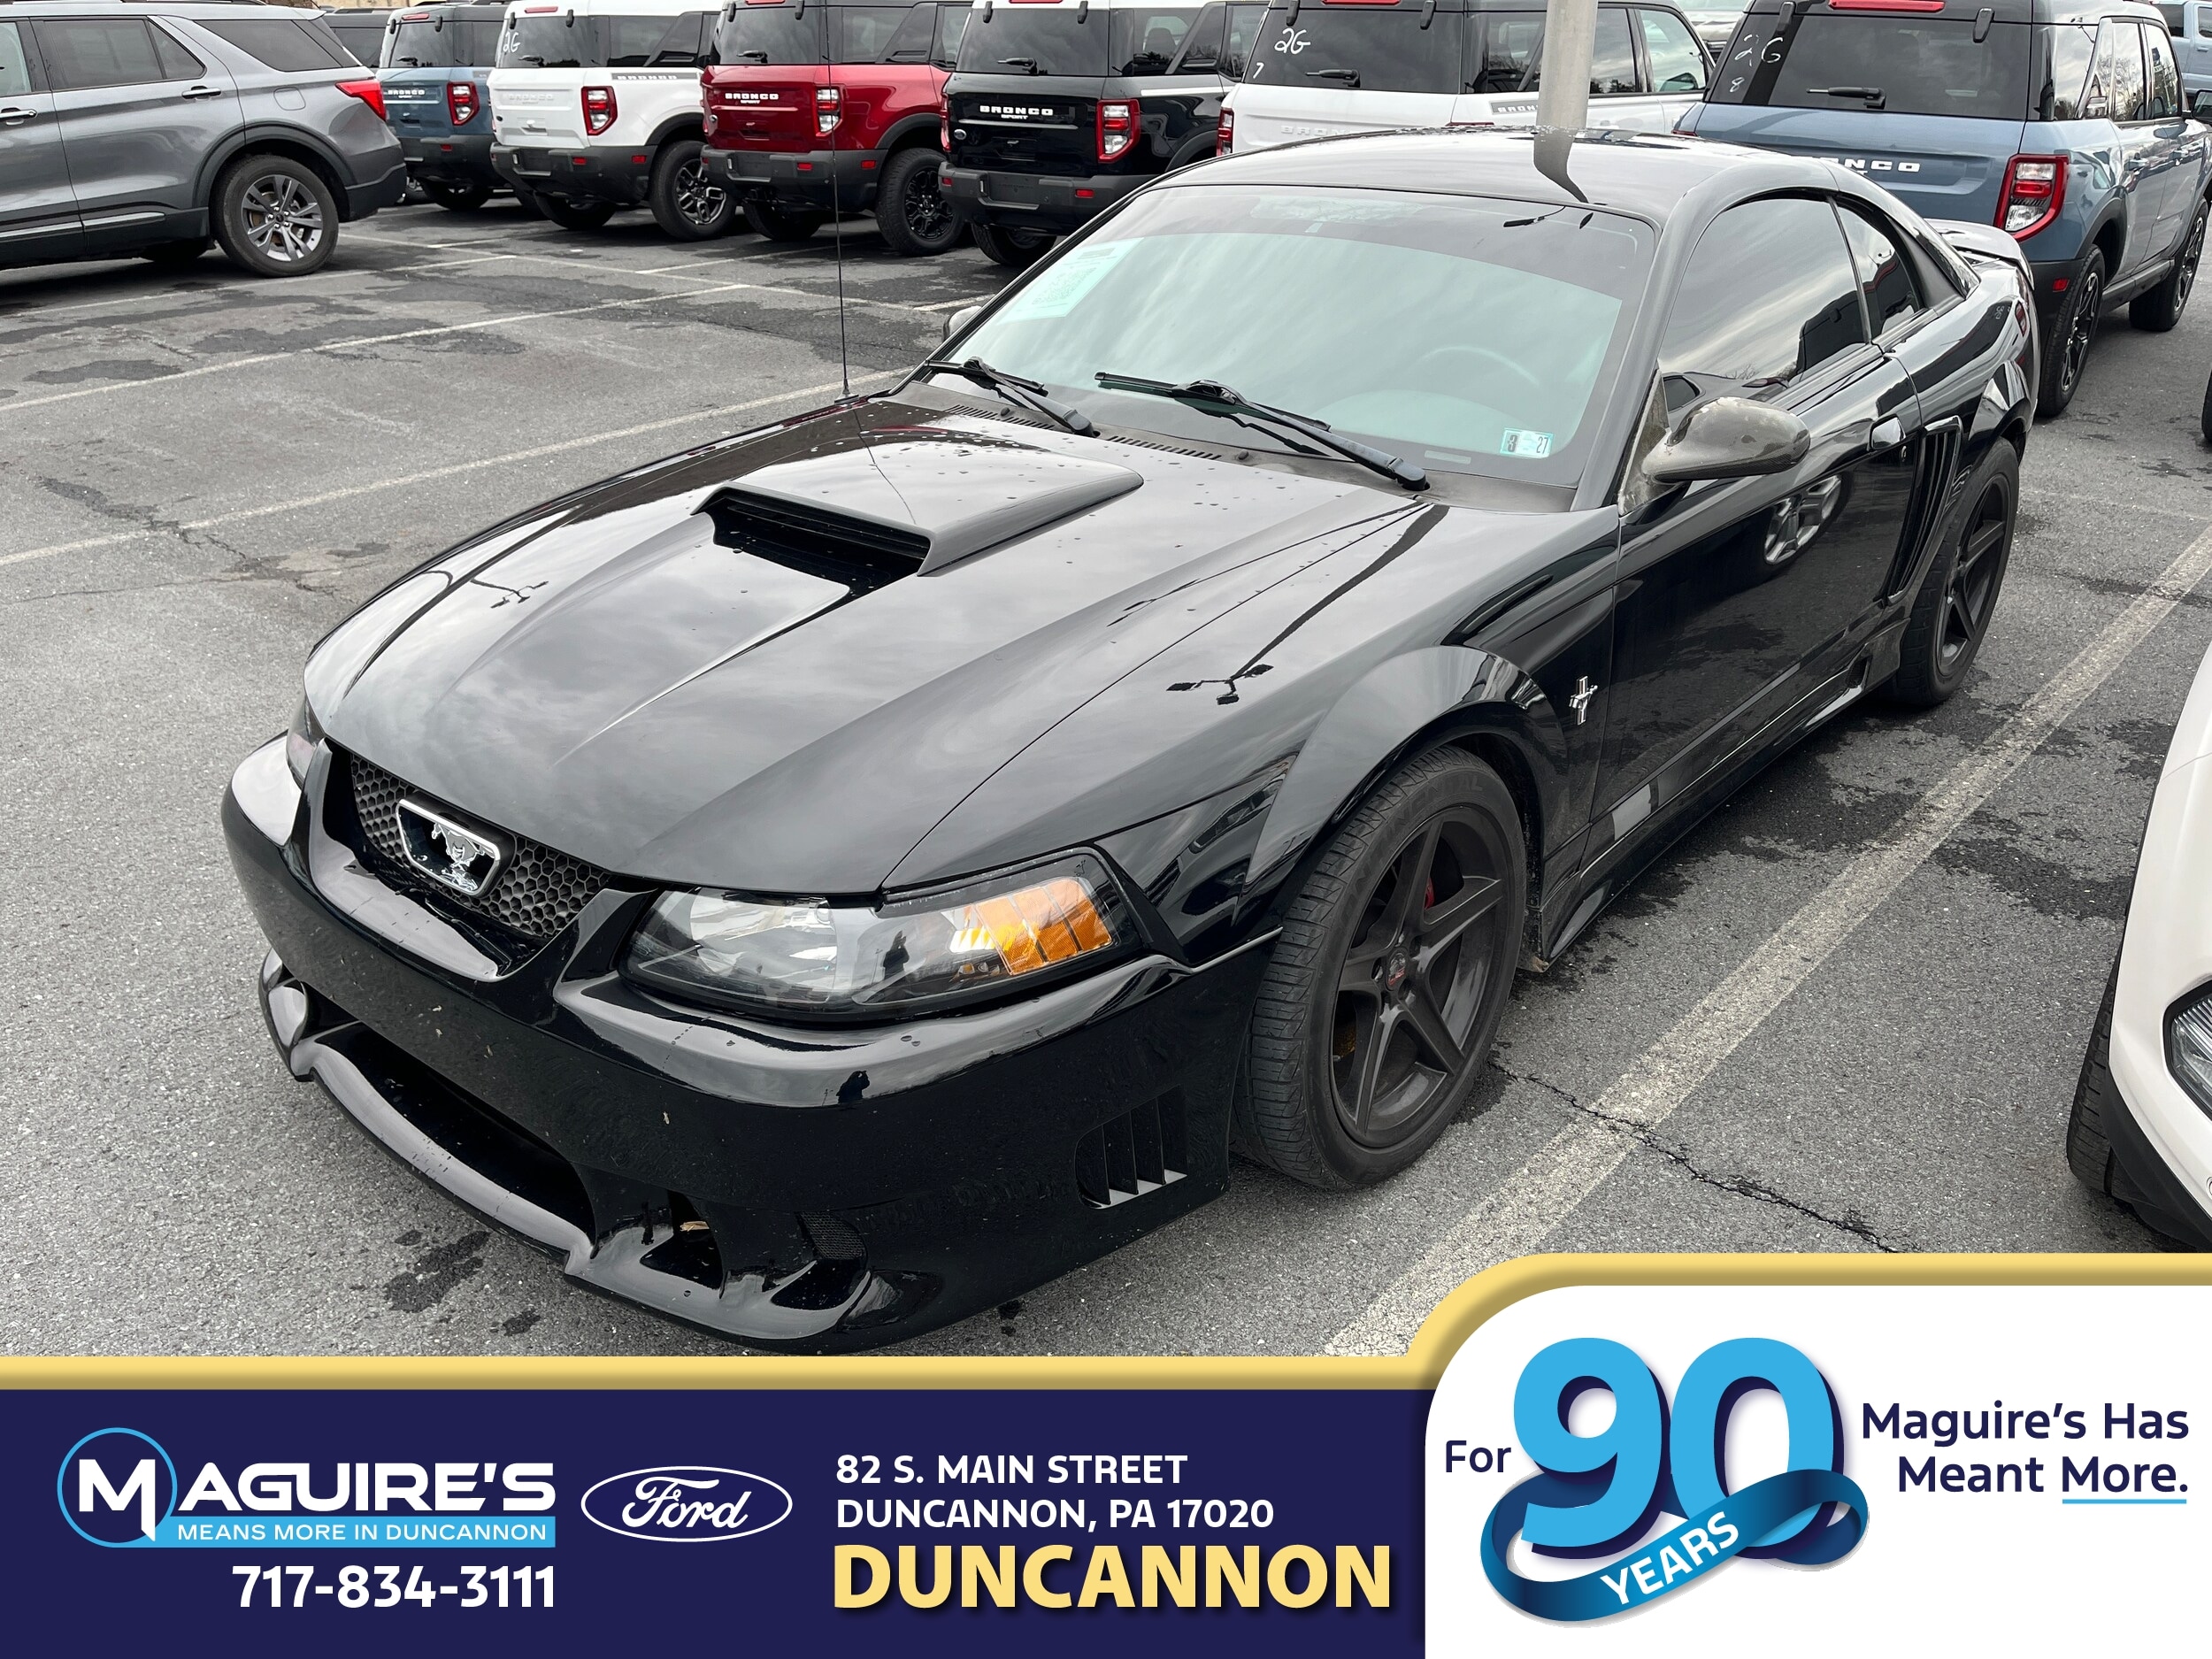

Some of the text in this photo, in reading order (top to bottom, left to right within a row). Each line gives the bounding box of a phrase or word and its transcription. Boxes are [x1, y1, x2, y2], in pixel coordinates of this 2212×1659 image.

[979, 105, 1053, 116] BRONCO
[1507, 434, 1549, 454] 3 27
